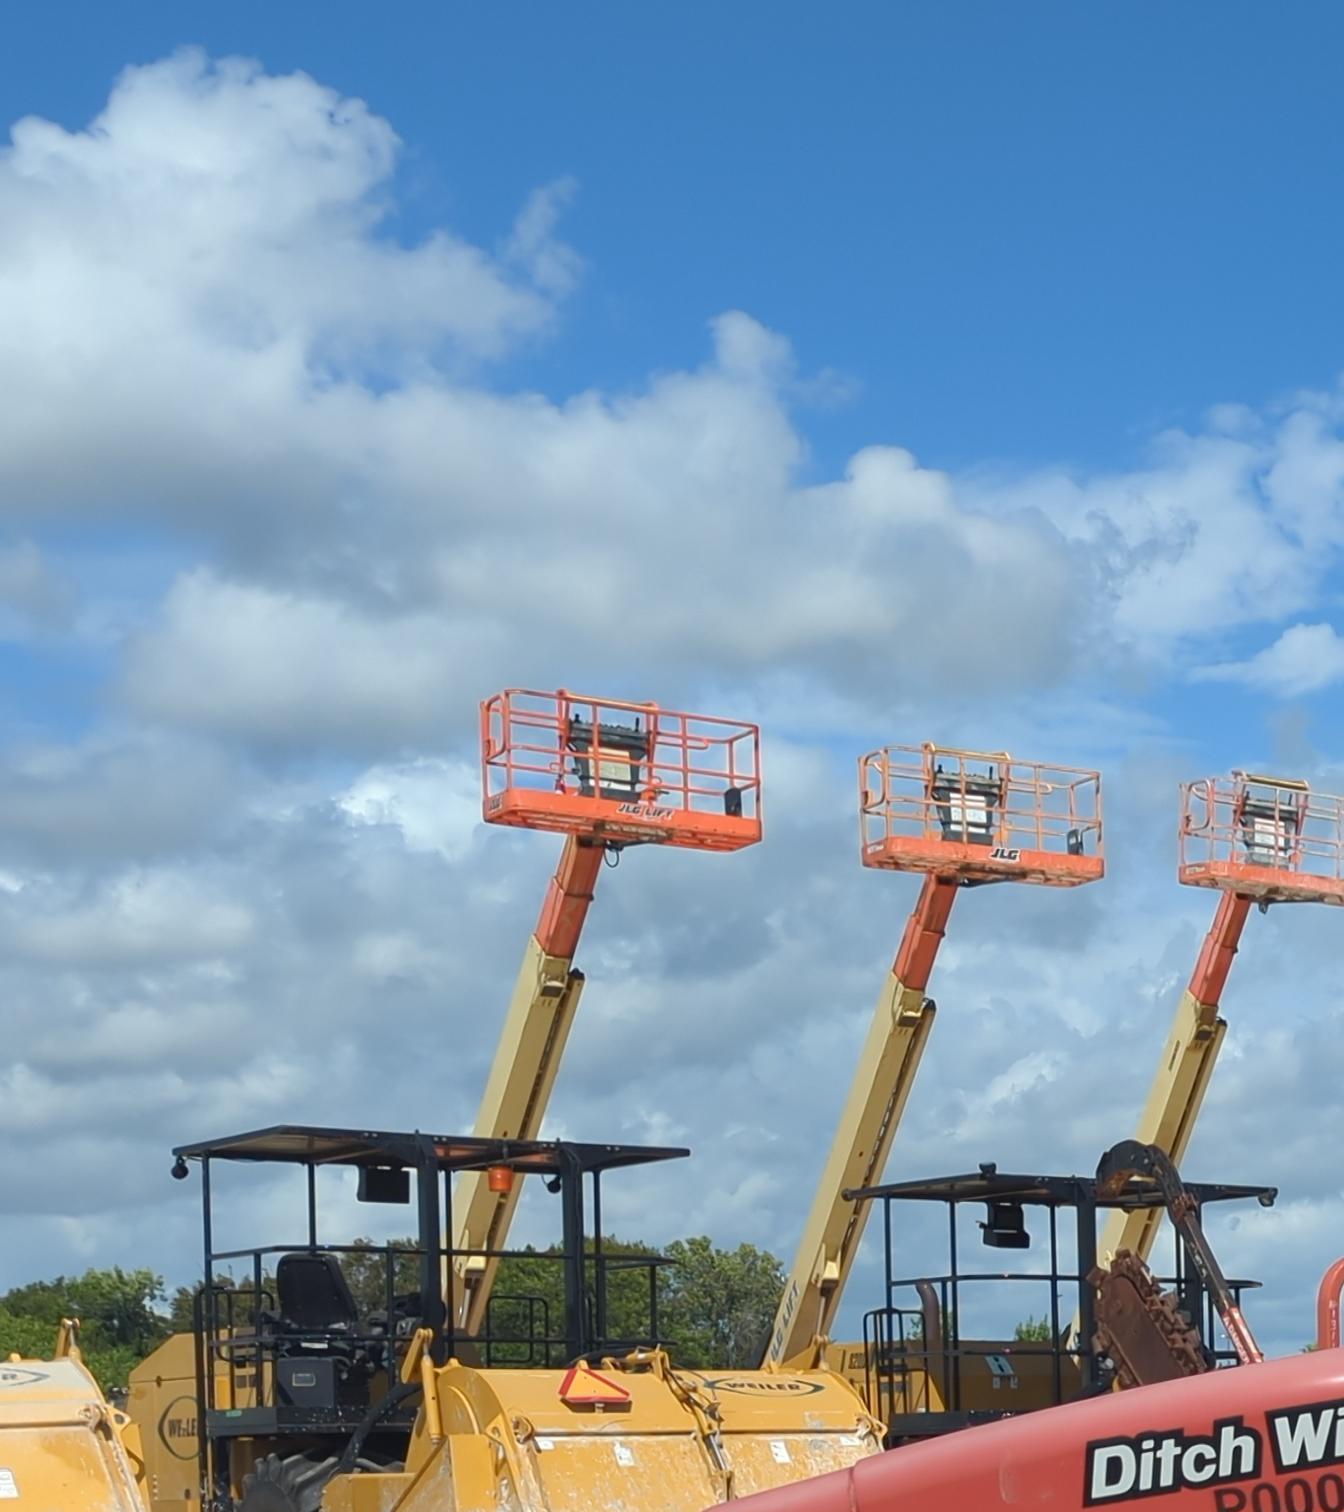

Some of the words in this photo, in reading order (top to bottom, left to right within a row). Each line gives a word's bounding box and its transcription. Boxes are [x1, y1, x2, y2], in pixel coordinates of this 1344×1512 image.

[617, 803, 641, 815] JLG
[990, 848, 1020, 861] JLG
[725, 1382, 801, 1391] WEILER
[168, 1417, 198, 1438] WEILE
[1090, 1425, 1257, 1500] Ditch
